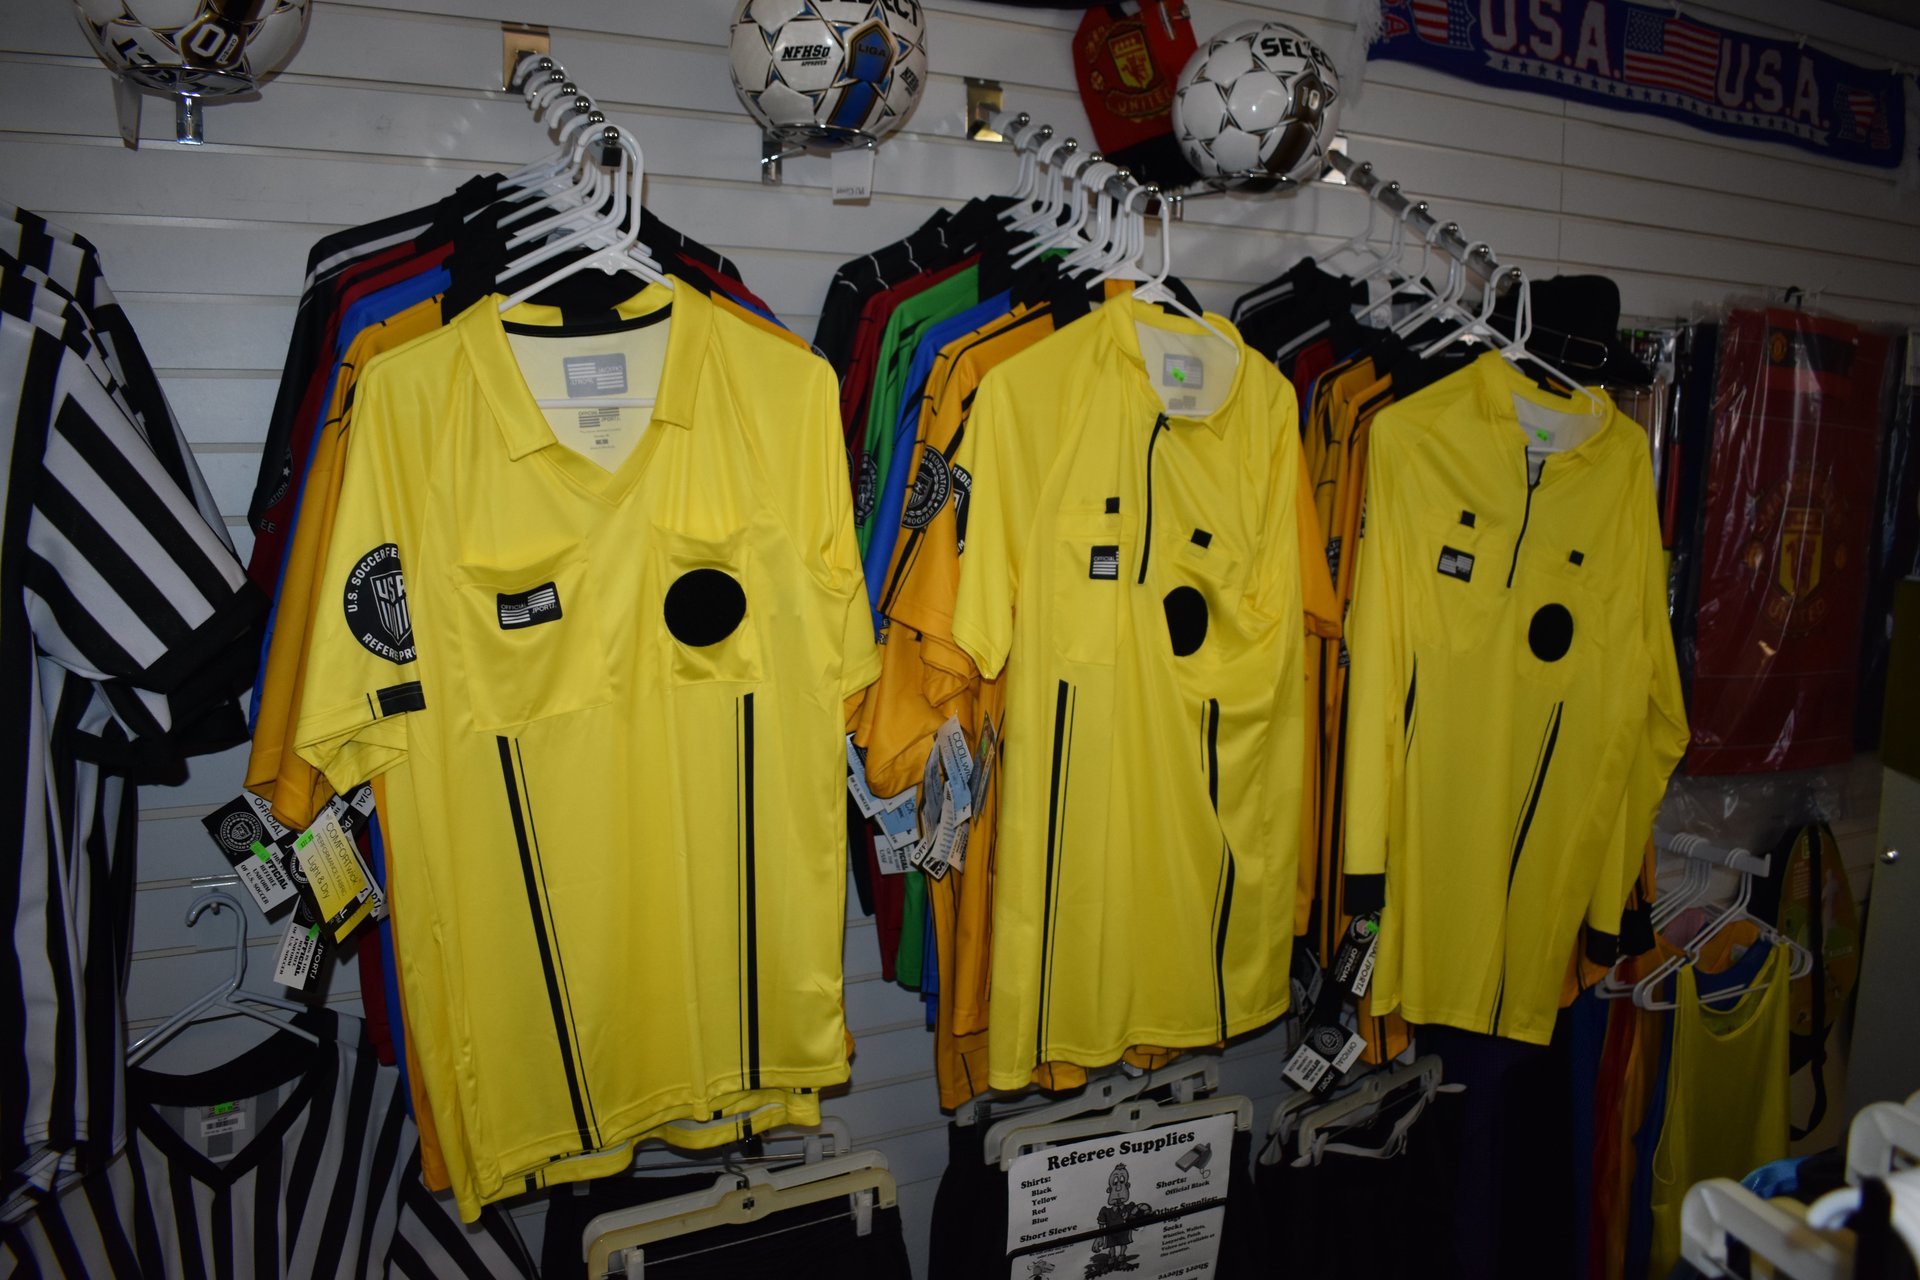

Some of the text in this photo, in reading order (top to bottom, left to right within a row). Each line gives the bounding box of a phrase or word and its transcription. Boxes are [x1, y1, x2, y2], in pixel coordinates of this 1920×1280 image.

[1260, 37, 1334, 73] SELEC
[254, 797, 284, 837] OFFICIAL
[307, 855, 321, 877] Light
[266, 859, 289, 890] FFICIAL
[1047, 1131, 1195, 1171] Referee Supplies
[1020, 1176, 1051, 1189] Shirts:
[1156, 1177, 1187, 1189] Shorts:
[1165, 1180, 1210, 1196] Official Black
[1031, 1187, 1052, 1197] Black
[1032, 1195, 1058, 1206] Yellow
[1032, 1207, 1047, 1216] Red
[1032, 1216, 1049, 1226] Blue
[1163, 1223, 1183, 1233] Socks
[1020, 1224, 1078, 1243] Short Sleeve
